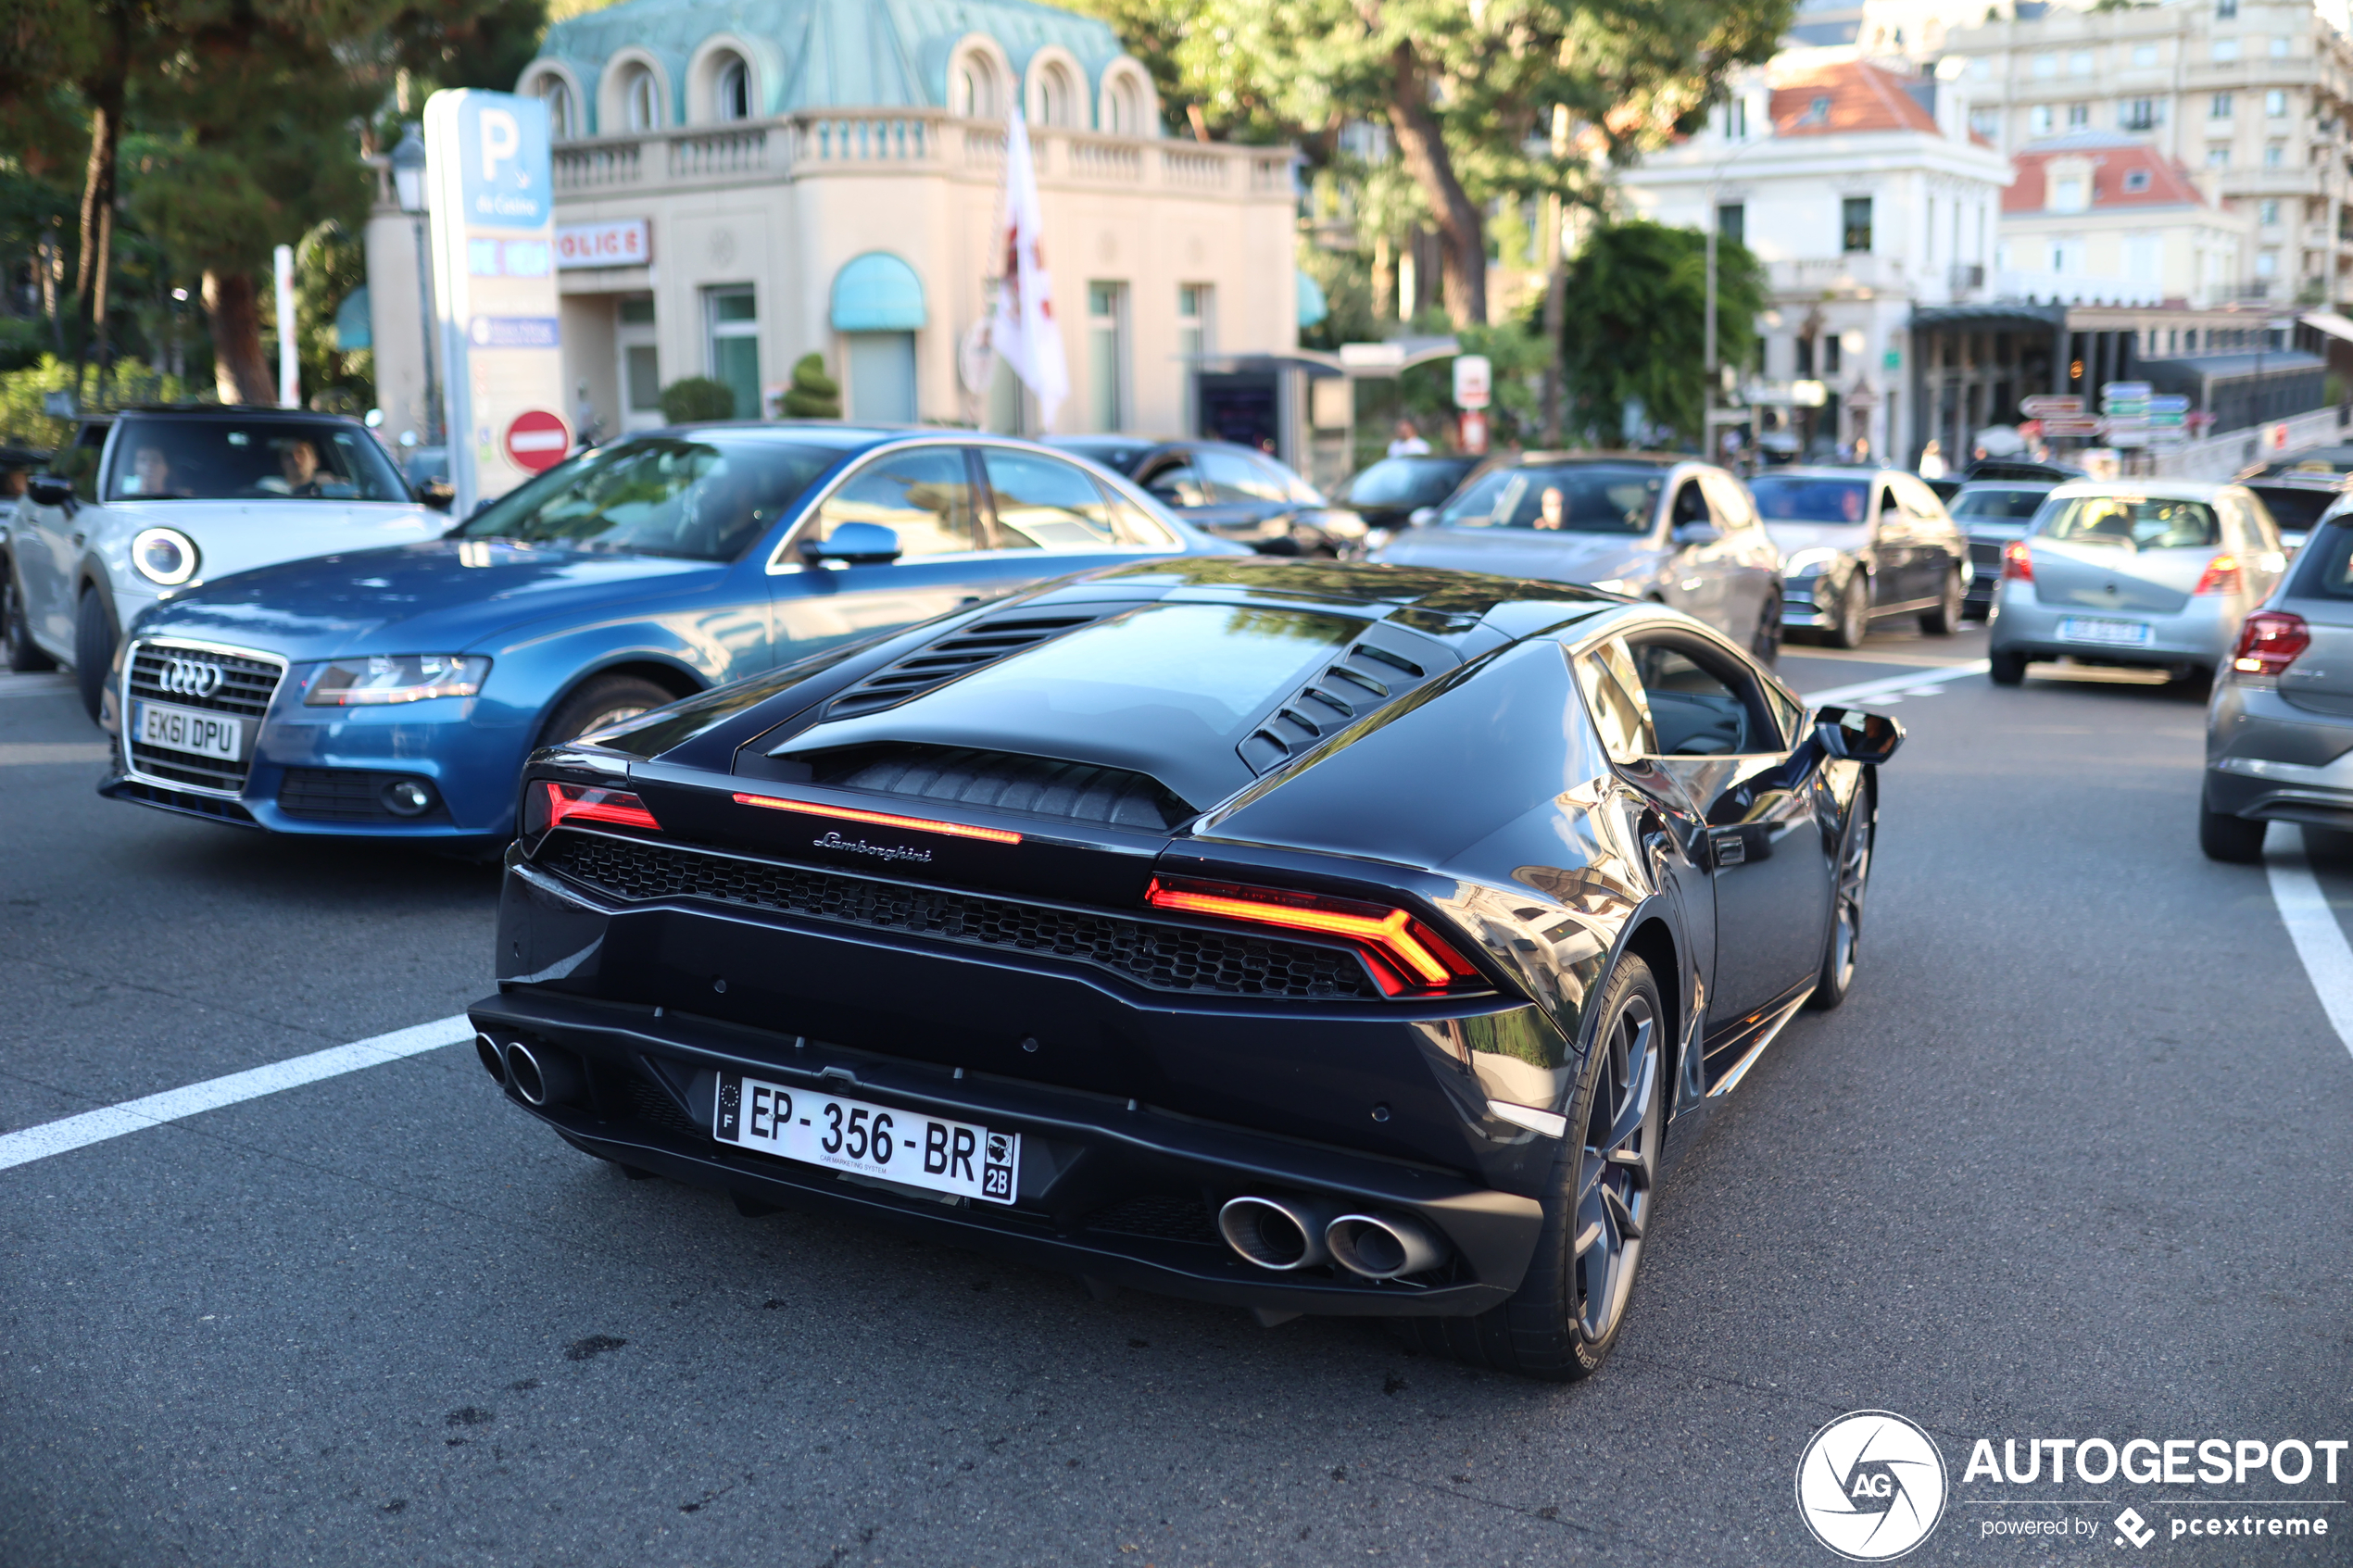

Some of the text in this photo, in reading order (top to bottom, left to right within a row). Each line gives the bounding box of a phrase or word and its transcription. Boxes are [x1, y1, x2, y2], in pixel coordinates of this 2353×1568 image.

[479, 107, 520, 182] P
[495, 193, 539, 218] Casino
[553, 230, 638, 257] OLICE
[147, 710, 233, 752] EK61 DPU
[812, 832, 932, 863] Lamborghini
[724, 1114, 733, 1128] F
[820, 1154, 887, 1174] CAR MARKETING SYSTEM
[986, 1168, 1008, 1195] 2B
[1575, 1342, 1598, 1370] ZERO
